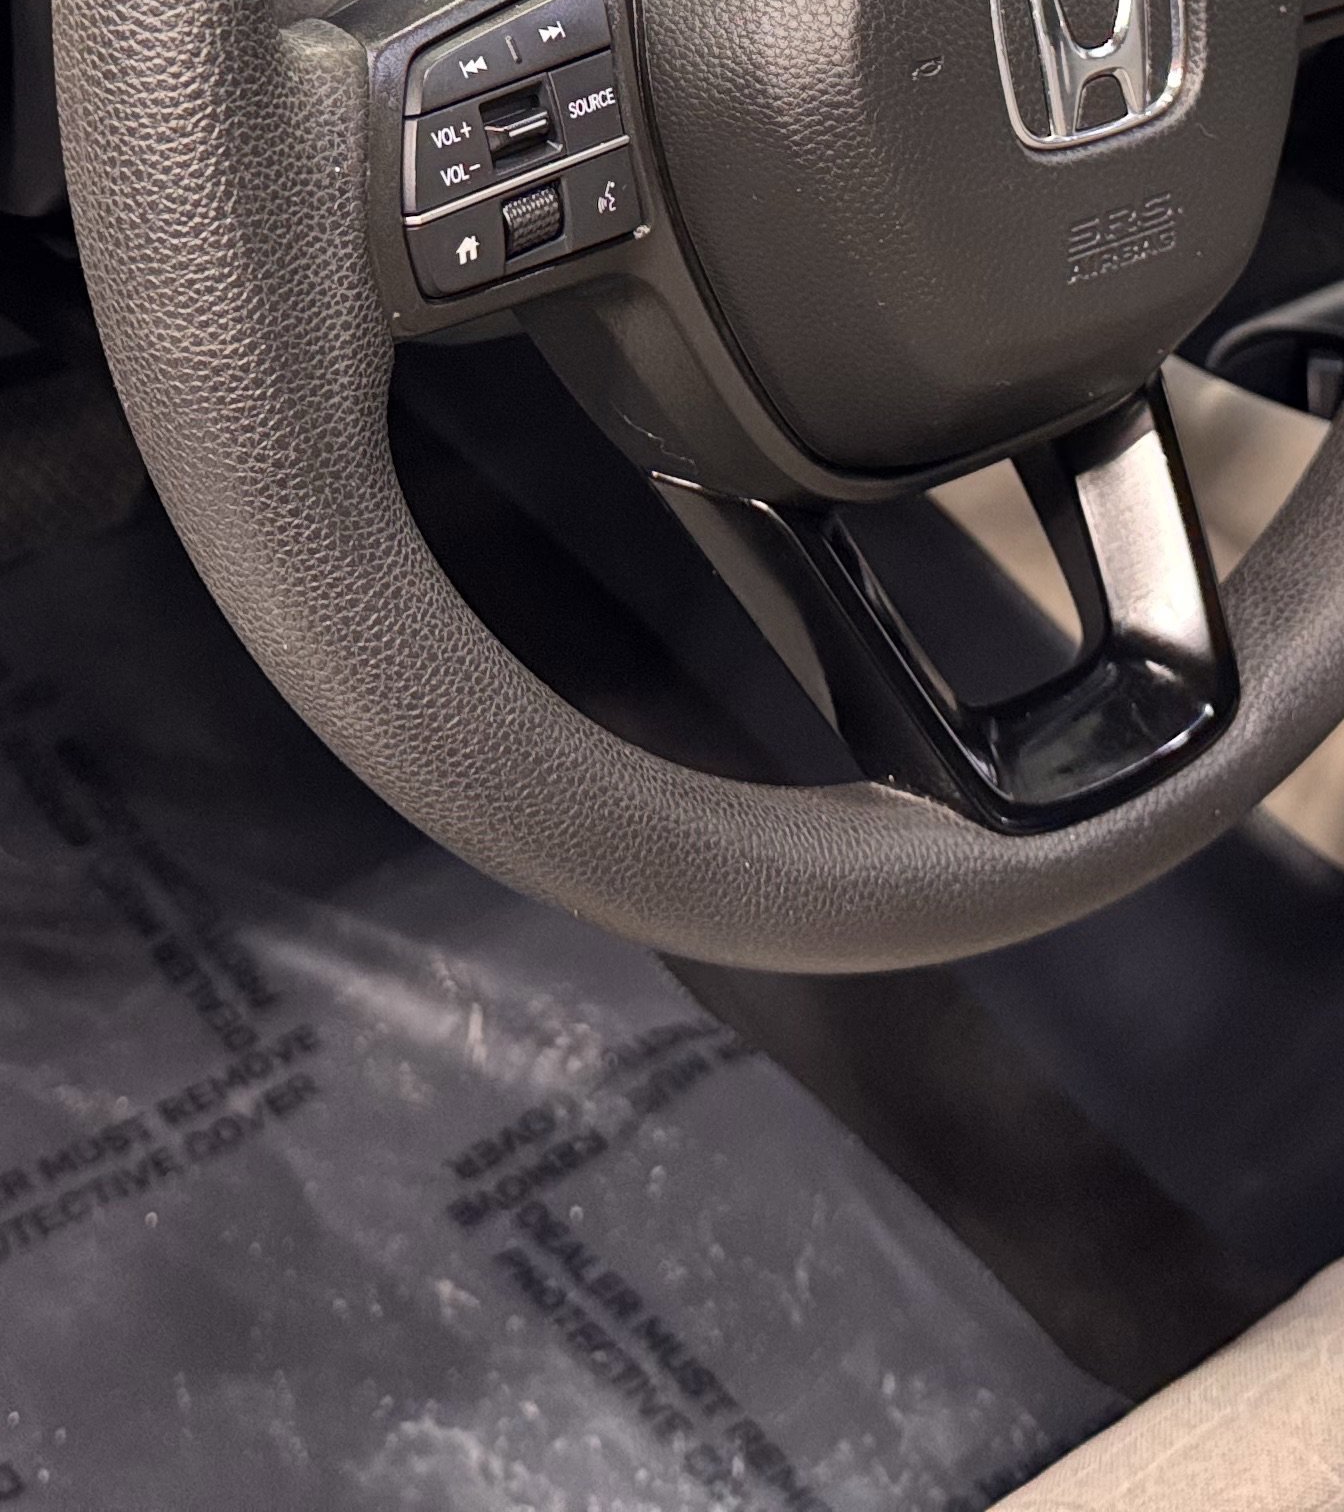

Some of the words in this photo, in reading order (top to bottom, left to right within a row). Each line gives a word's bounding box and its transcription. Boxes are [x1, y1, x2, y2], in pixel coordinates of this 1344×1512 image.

[568, 87, 616, 119] SOURCE
[431, 121, 473, 148] VOL+
[37, 1112, 154, 1184] MUST
[155, 1022, 324, 1129] REMOVE
